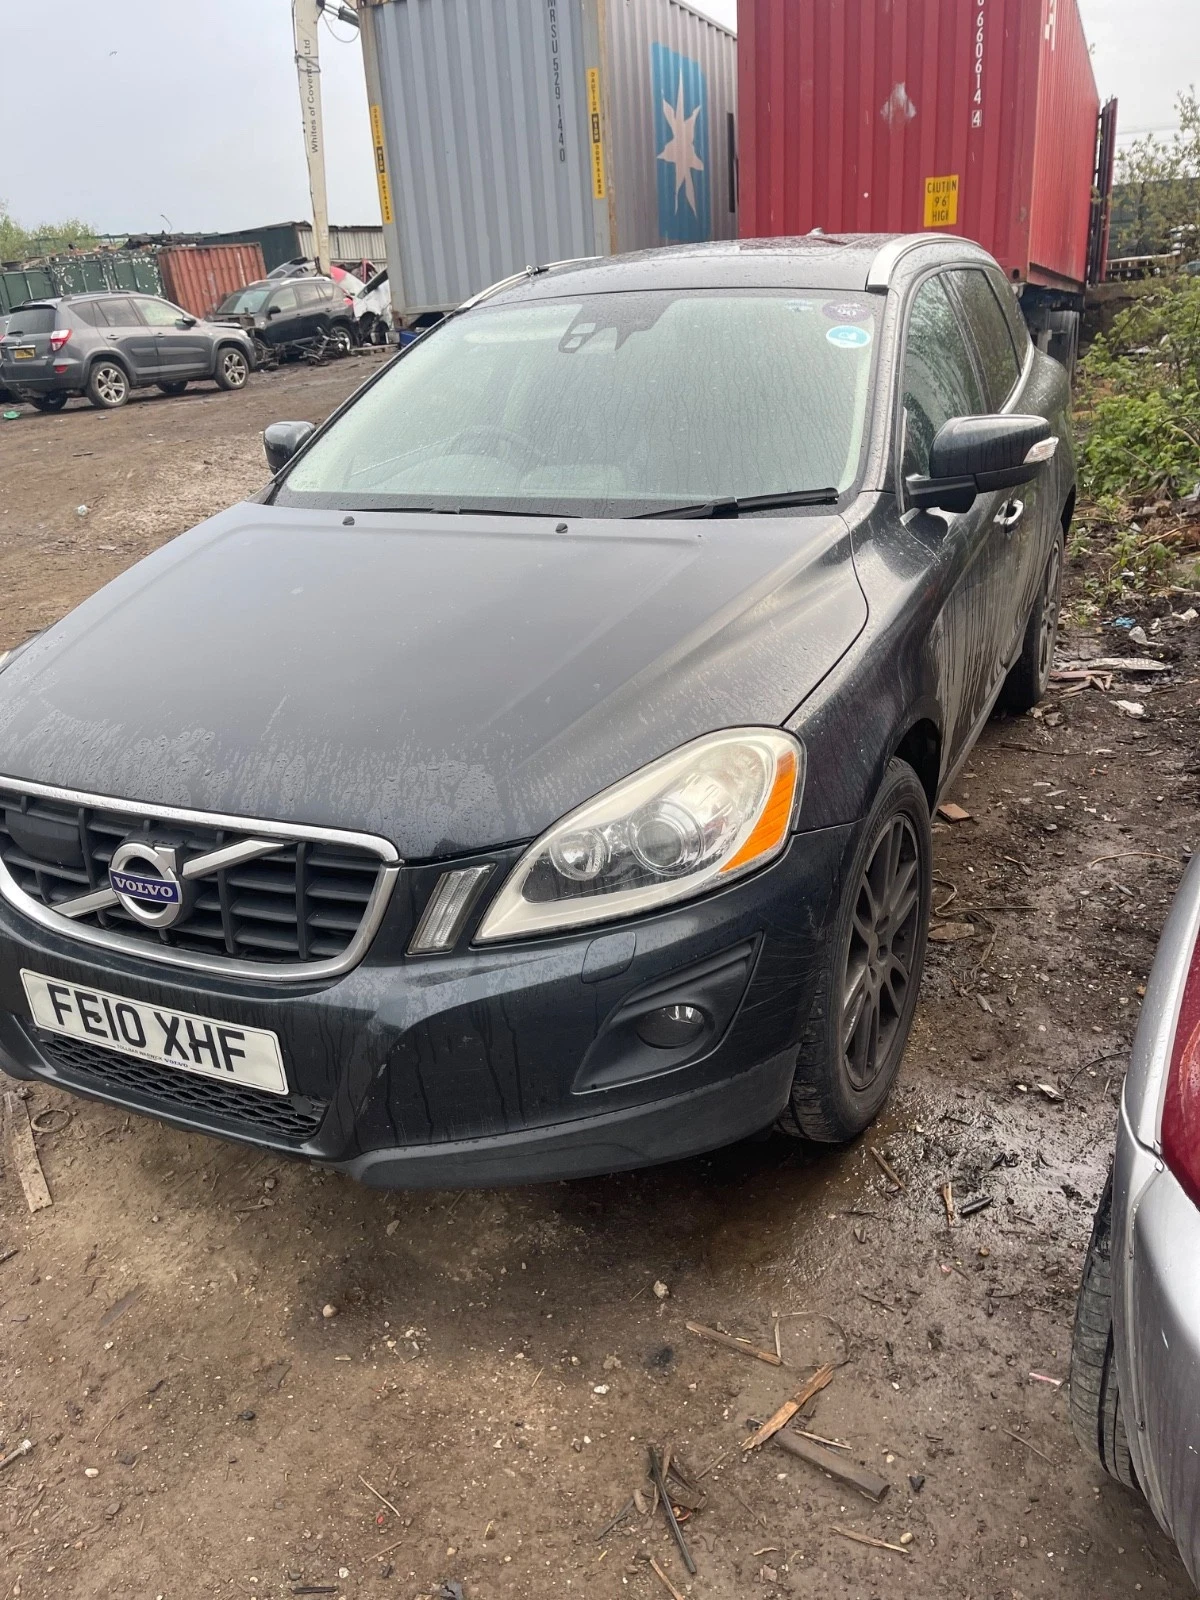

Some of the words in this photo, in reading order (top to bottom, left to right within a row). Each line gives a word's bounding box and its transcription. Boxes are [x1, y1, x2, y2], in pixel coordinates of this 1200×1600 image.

[303, 39, 311, 55] Ltd
[309, 106, 315, 115] of
[310, 120, 318, 153] Whites
[113, 876, 173, 897] VOLVO
[46, 982, 147, 1049] FE10
[154, 1011, 246, 1073] XHF
